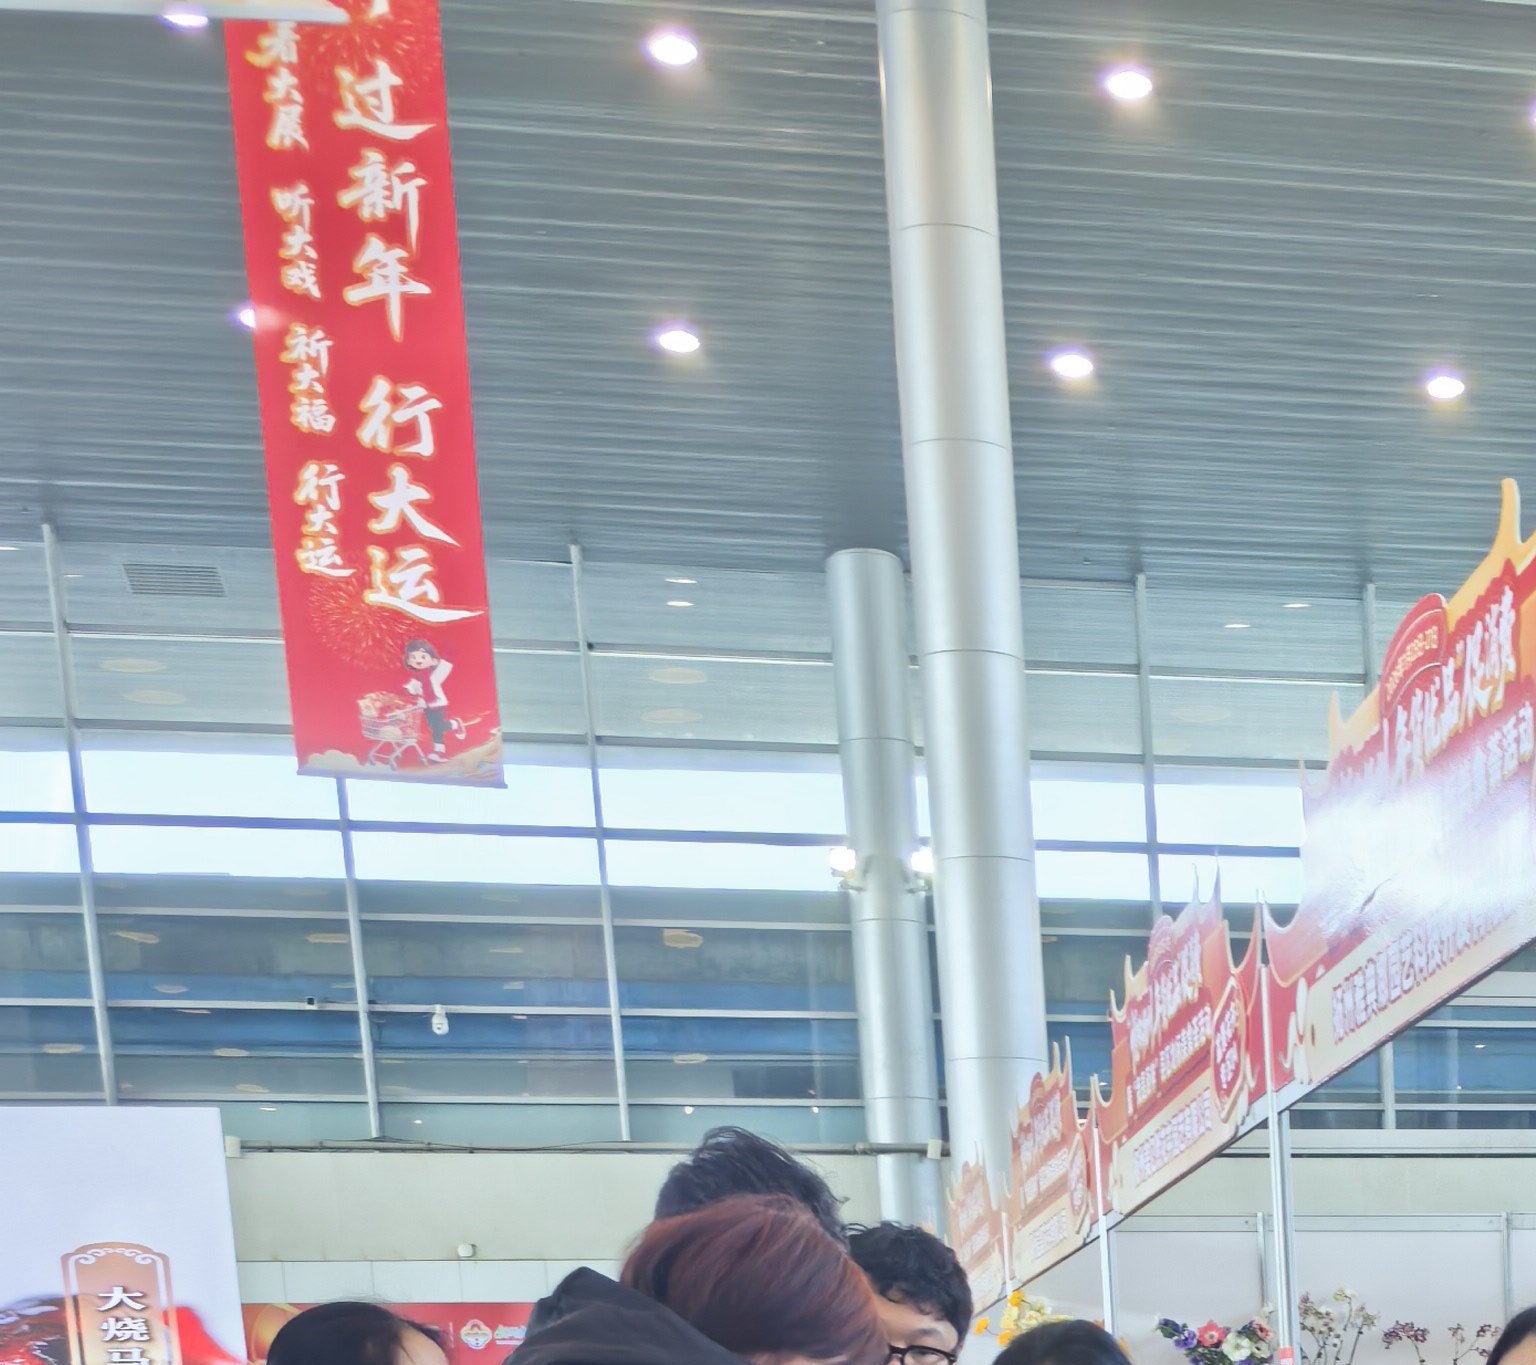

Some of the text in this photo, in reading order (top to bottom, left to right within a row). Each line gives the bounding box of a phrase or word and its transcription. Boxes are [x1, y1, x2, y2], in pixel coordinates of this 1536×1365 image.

[270, 184, 322, 300] 听大戏
[333, 60, 486, 624] 过新年 行大运
[294, 462, 358, 577] 行大运
